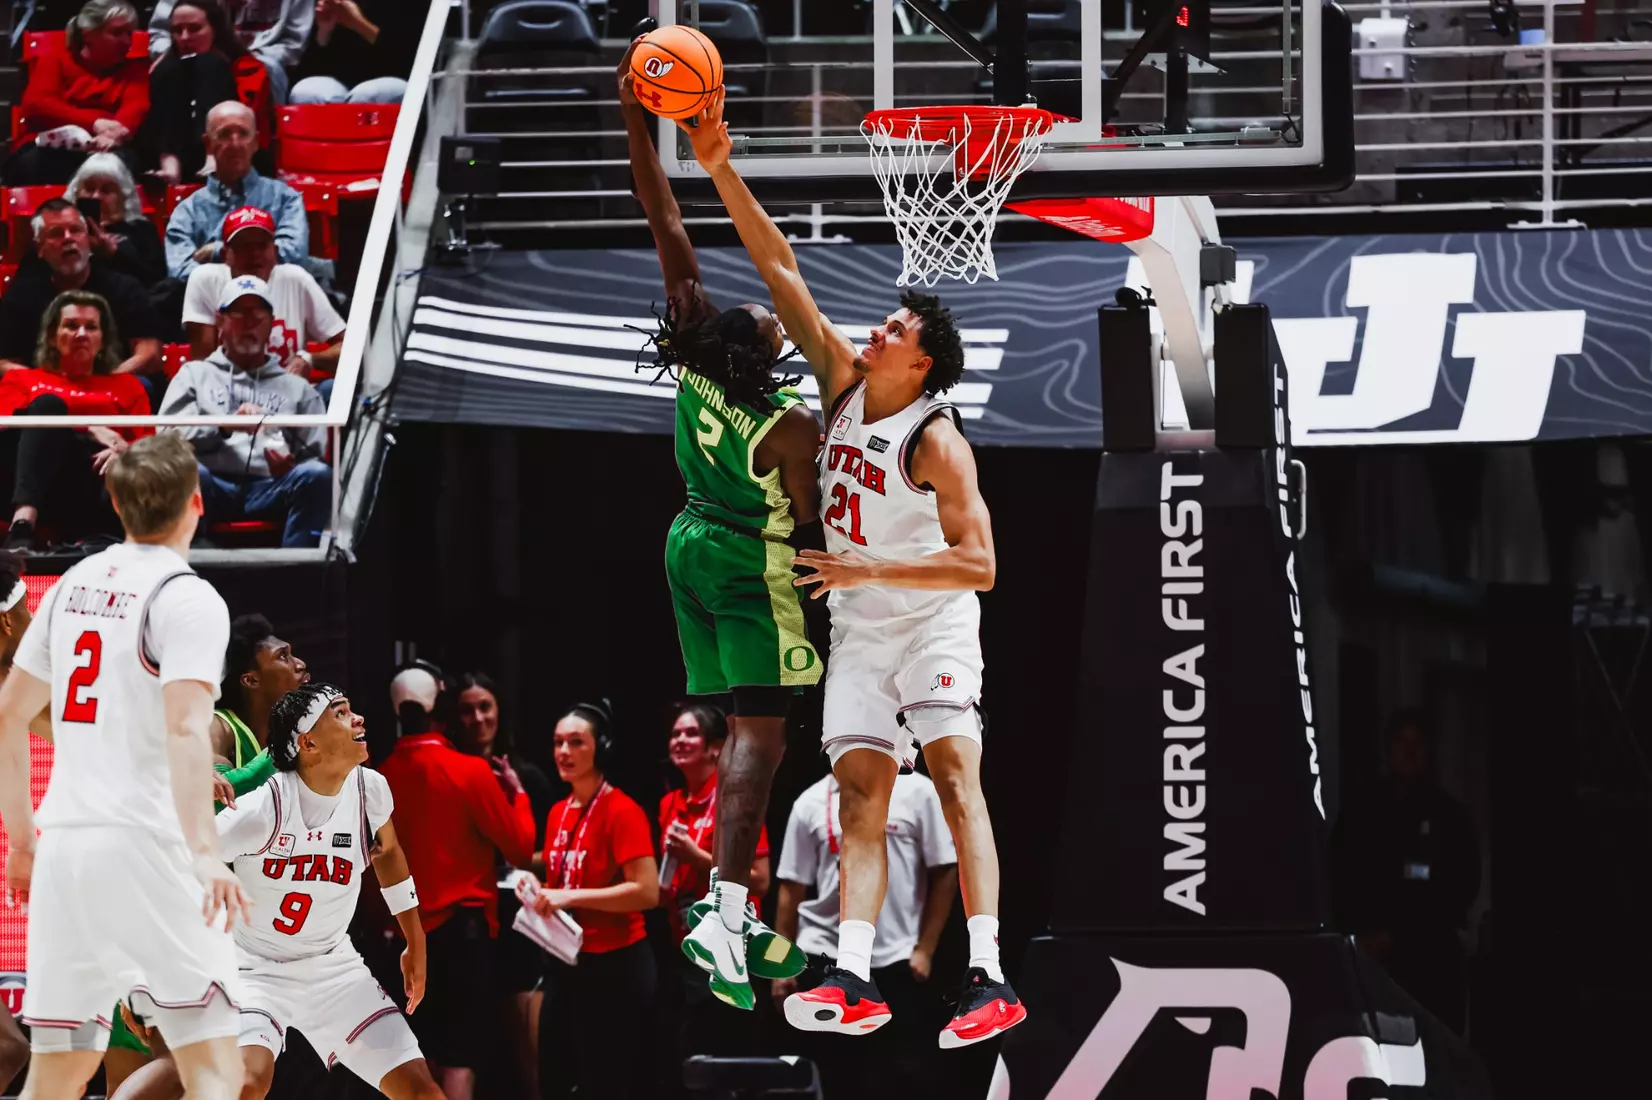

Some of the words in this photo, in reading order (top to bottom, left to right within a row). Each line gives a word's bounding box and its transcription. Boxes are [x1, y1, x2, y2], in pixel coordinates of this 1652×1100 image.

[686, 372, 757, 441] JOHNSON
[695, 406, 725, 467] 2
[827, 444, 887, 497] UTAH
[1273, 363, 1293, 538] FIRST
[824, 482, 868, 546] 21
[1160, 461, 1205, 631] FIRST
[62, 630, 103, 724] 2
[783, 645, 816, 672] O
[940, 675, 952, 687] U
[1286, 550, 1326, 820] AMERICA
[1162, 643, 1206, 916] AMERICA
[262, 854, 353, 886] UTAH
[272, 891, 313, 936] 9
